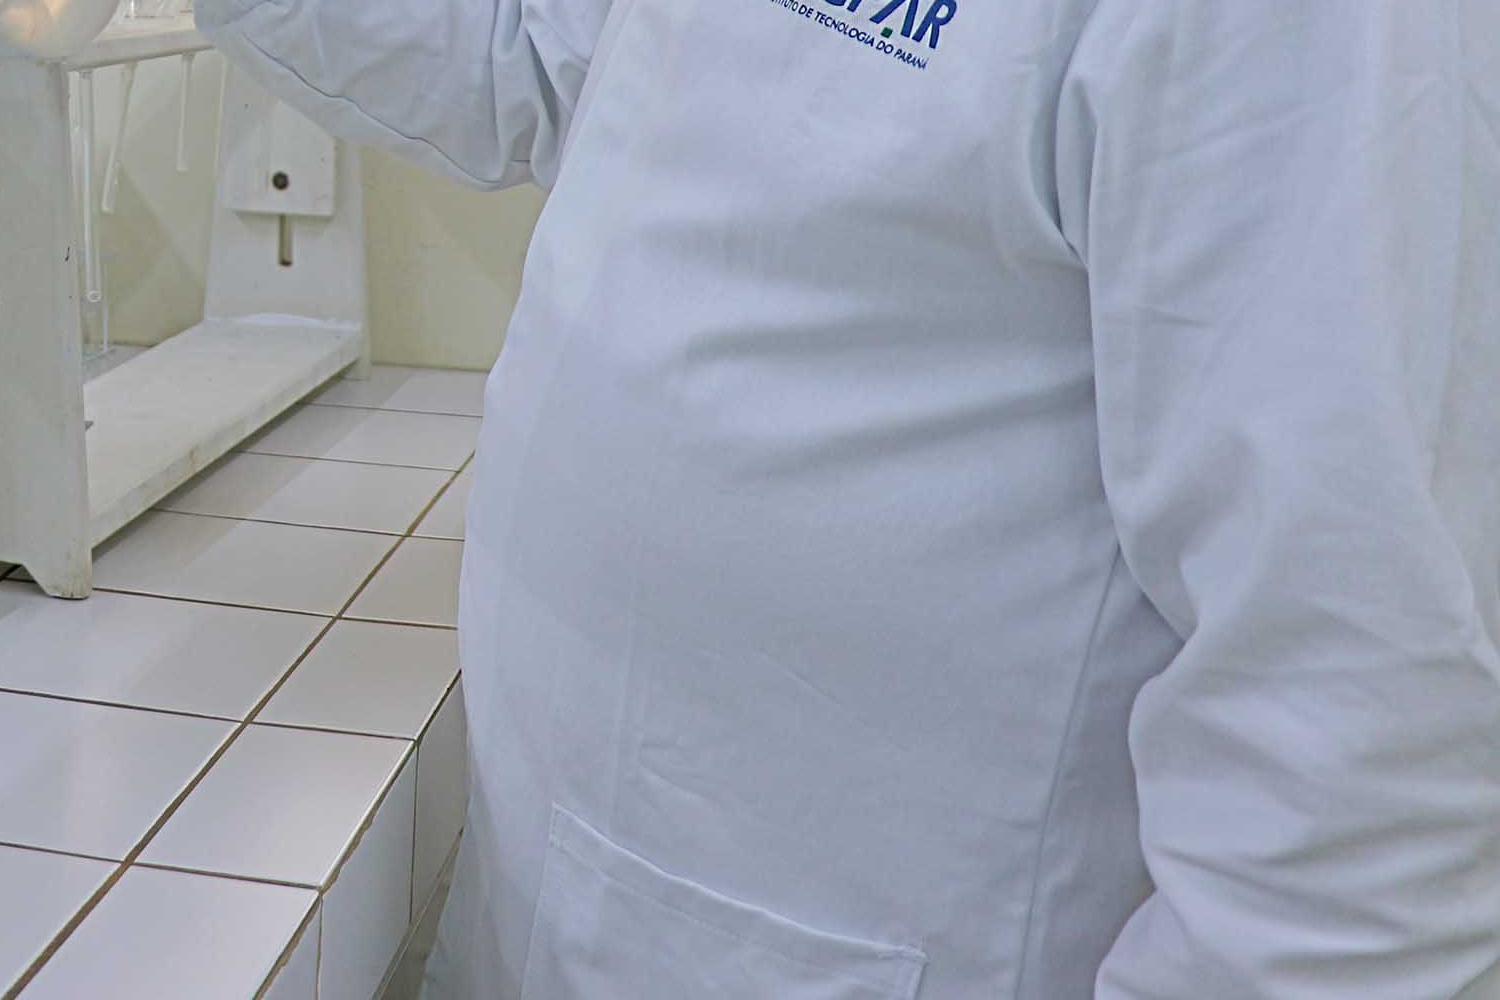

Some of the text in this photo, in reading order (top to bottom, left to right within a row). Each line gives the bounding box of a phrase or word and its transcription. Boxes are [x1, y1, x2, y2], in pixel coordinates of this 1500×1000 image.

[798, 3, 814, 18] DE
[814, 10, 875, 47] TECNOLOGIA
[876, 40, 894, 55] DO
[893, 48, 928, 70] PARANÁ
